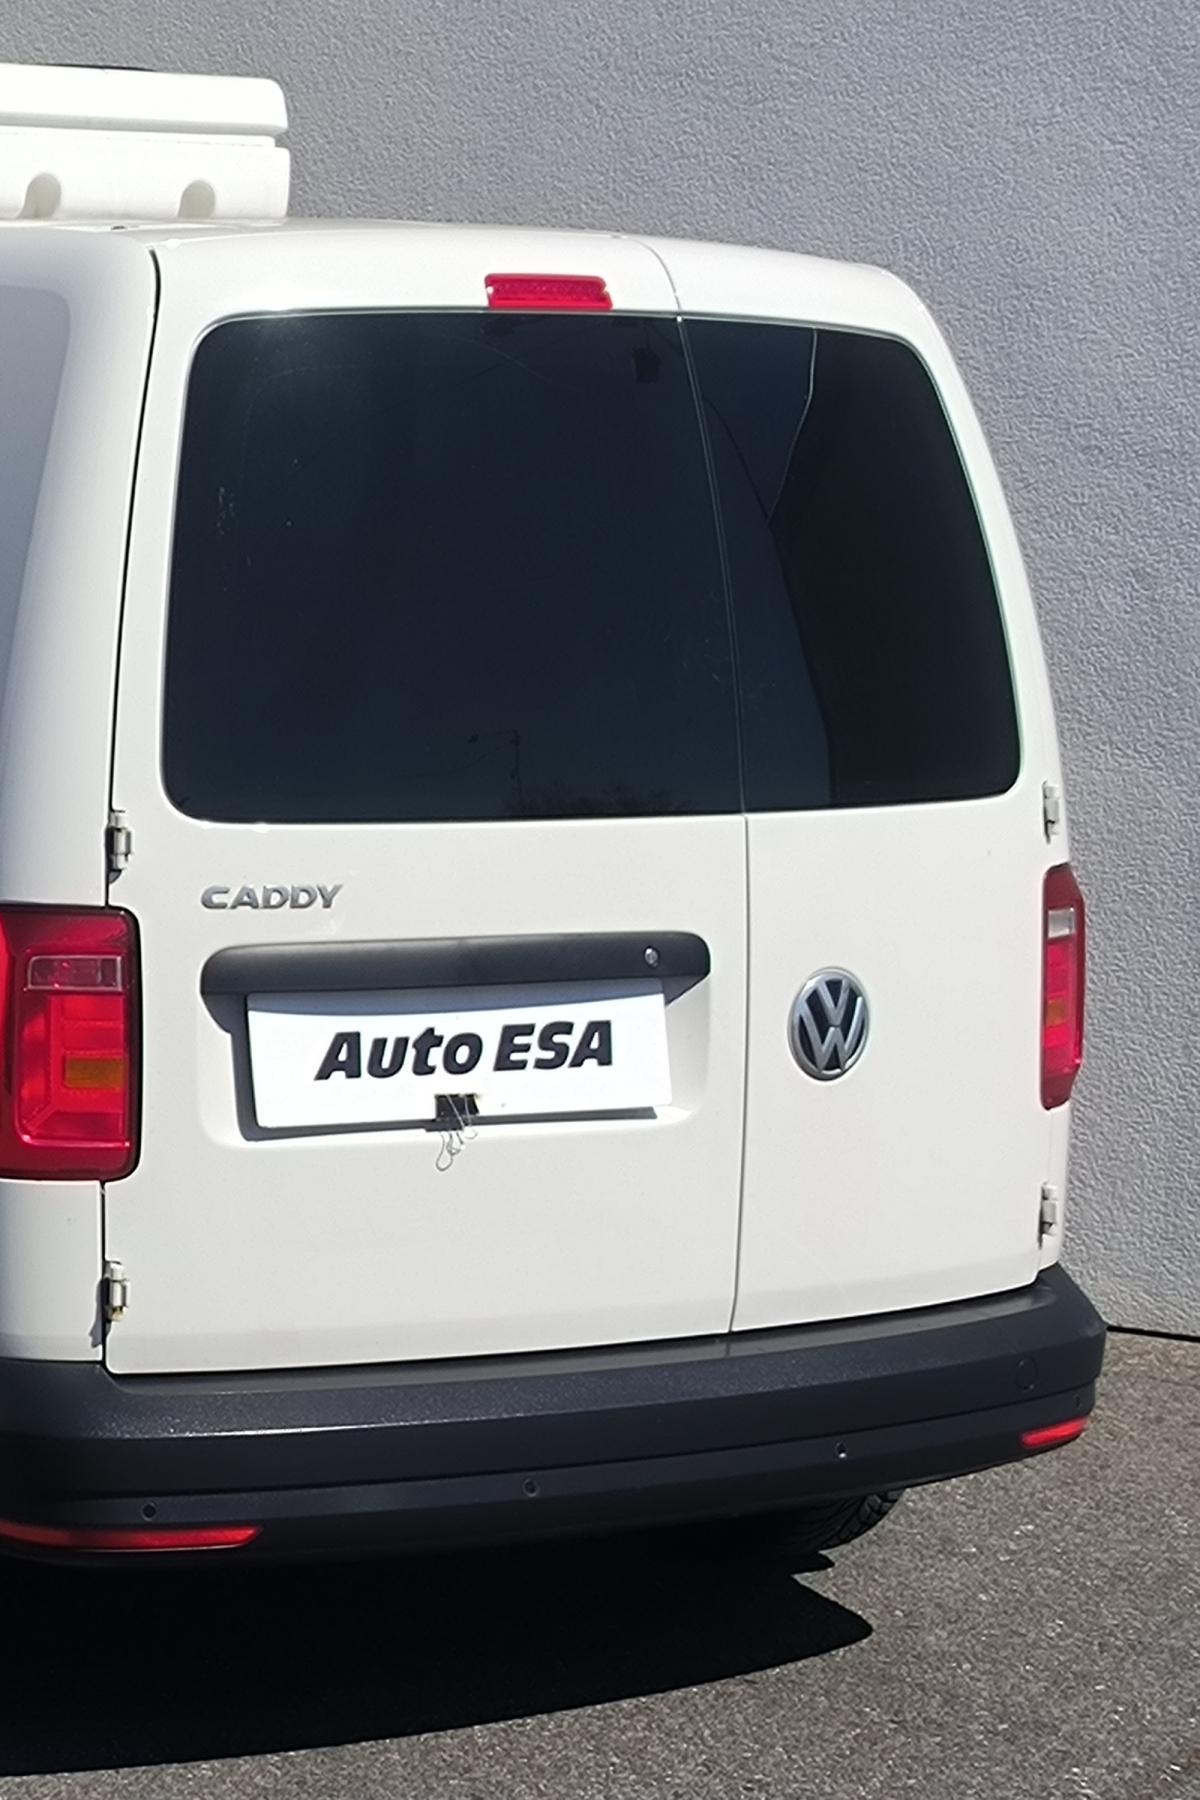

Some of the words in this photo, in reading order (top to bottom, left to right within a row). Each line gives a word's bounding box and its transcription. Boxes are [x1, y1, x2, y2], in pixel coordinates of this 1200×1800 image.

[200, 884, 344, 910] CADDY
[313, 1026, 484, 1082] Auto
[492, 1019, 613, 1073] ESA
